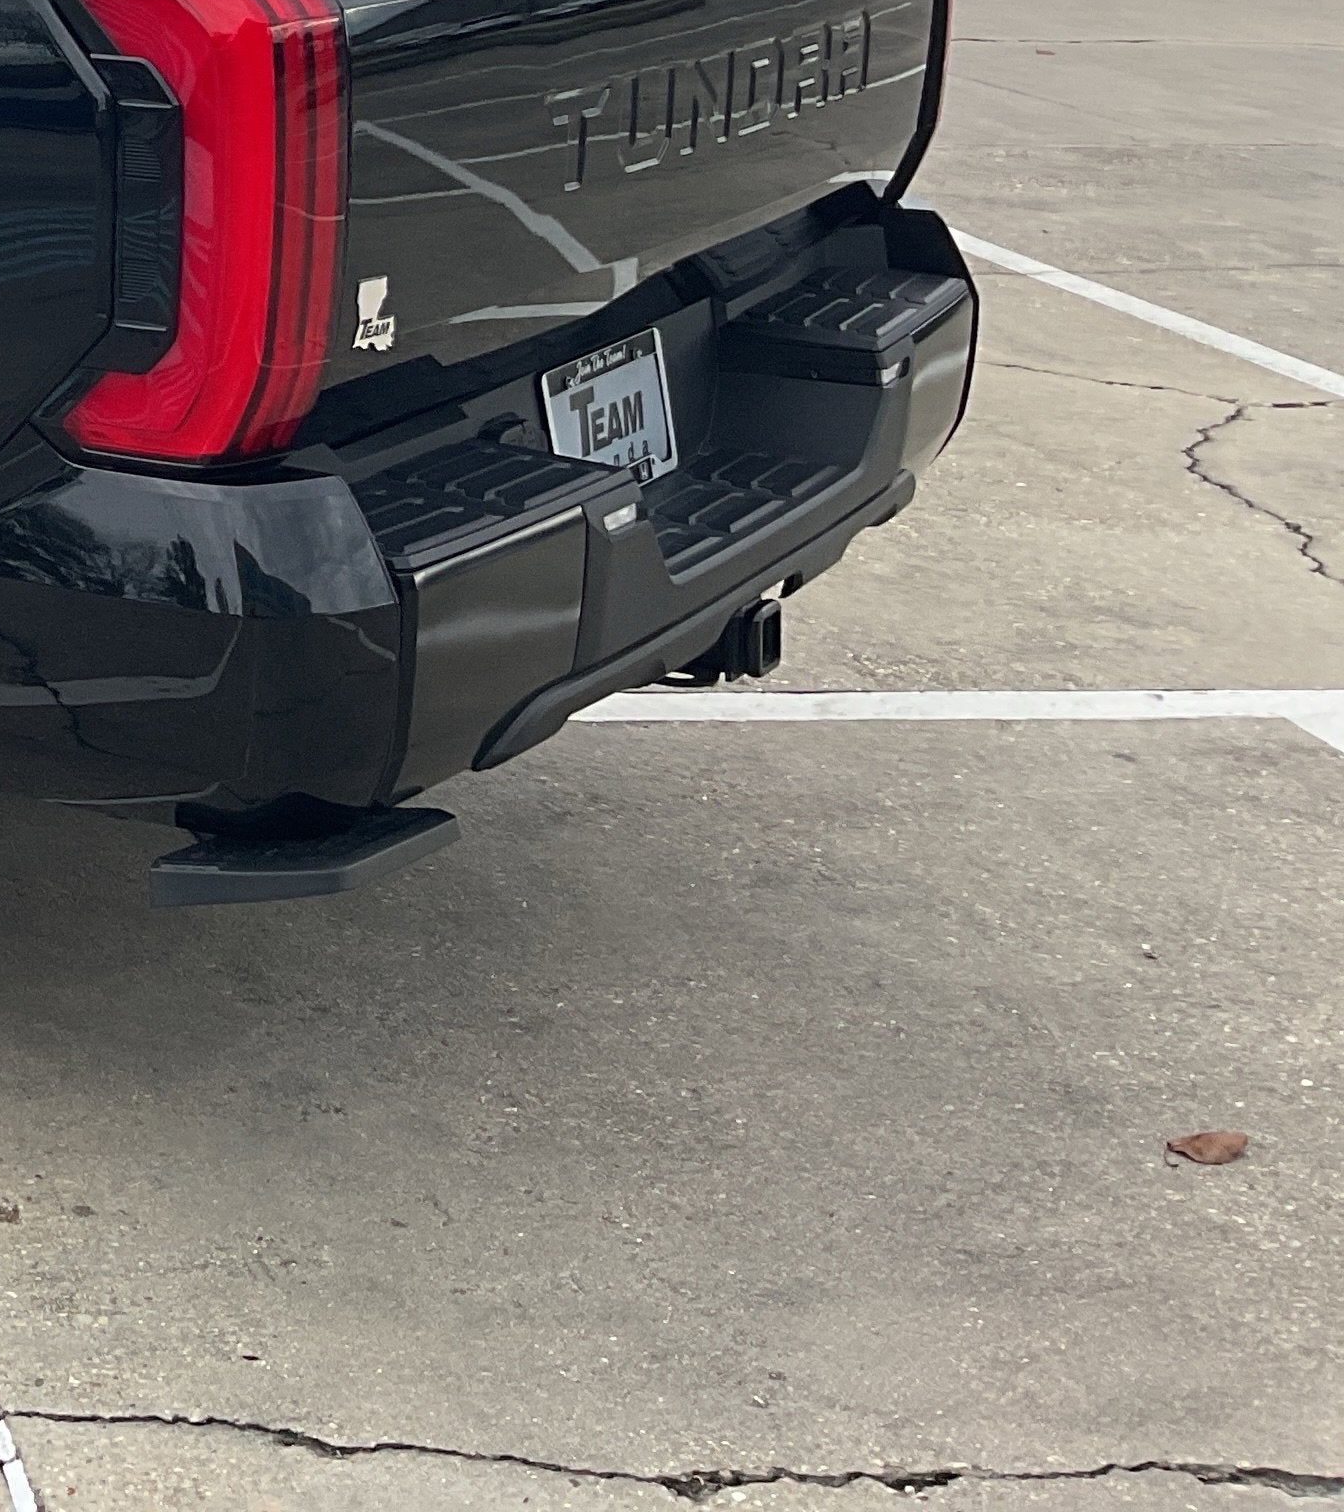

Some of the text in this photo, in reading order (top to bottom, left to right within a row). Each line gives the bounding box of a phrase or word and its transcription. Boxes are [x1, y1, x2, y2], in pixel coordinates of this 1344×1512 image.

[543, 9, 871, 193] TUNDRA
[359, 318, 391, 341] TEAM
[573, 344, 628, 385] Join The Team!
[568, 385, 645, 458] TEAM
